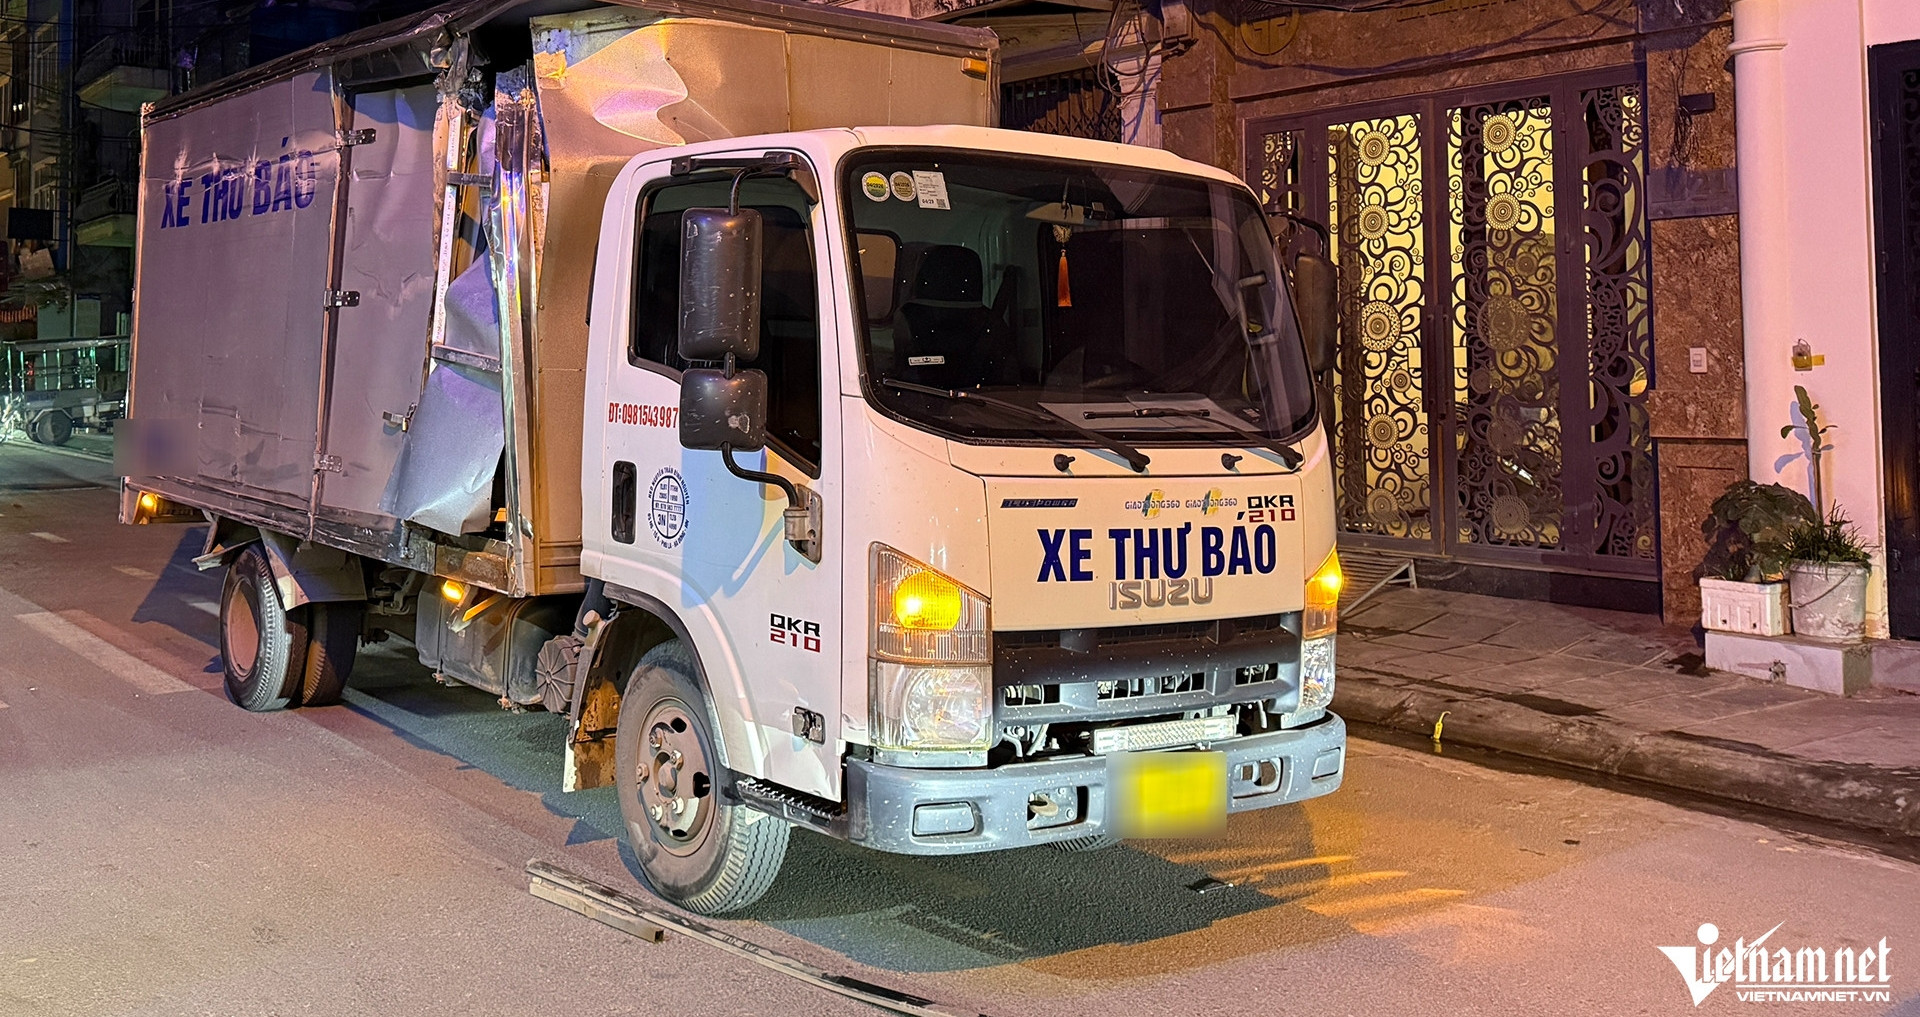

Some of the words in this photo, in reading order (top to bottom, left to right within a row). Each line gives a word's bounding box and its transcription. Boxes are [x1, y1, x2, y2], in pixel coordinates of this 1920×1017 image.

[161, 178, 192, 229] XE
[252, 136, 316, 215] BÁO
[608, 402, 678, 428] ĐT:0981543987
[1247, 495, 1294, 508] QKR
[657, 514, 666, 527] 3N
[1248, 508, 1296, 523] 210
[1037, 529, 1093, 582] XE
[1108, 521, 1191, 580] THƯ
[1202, 511, 1277, 577] BÁO
[1108, 577, 1213, 610] ISUZU
[770, 613, 820, 637] QKR
[770, 632, 821, 653] 210
